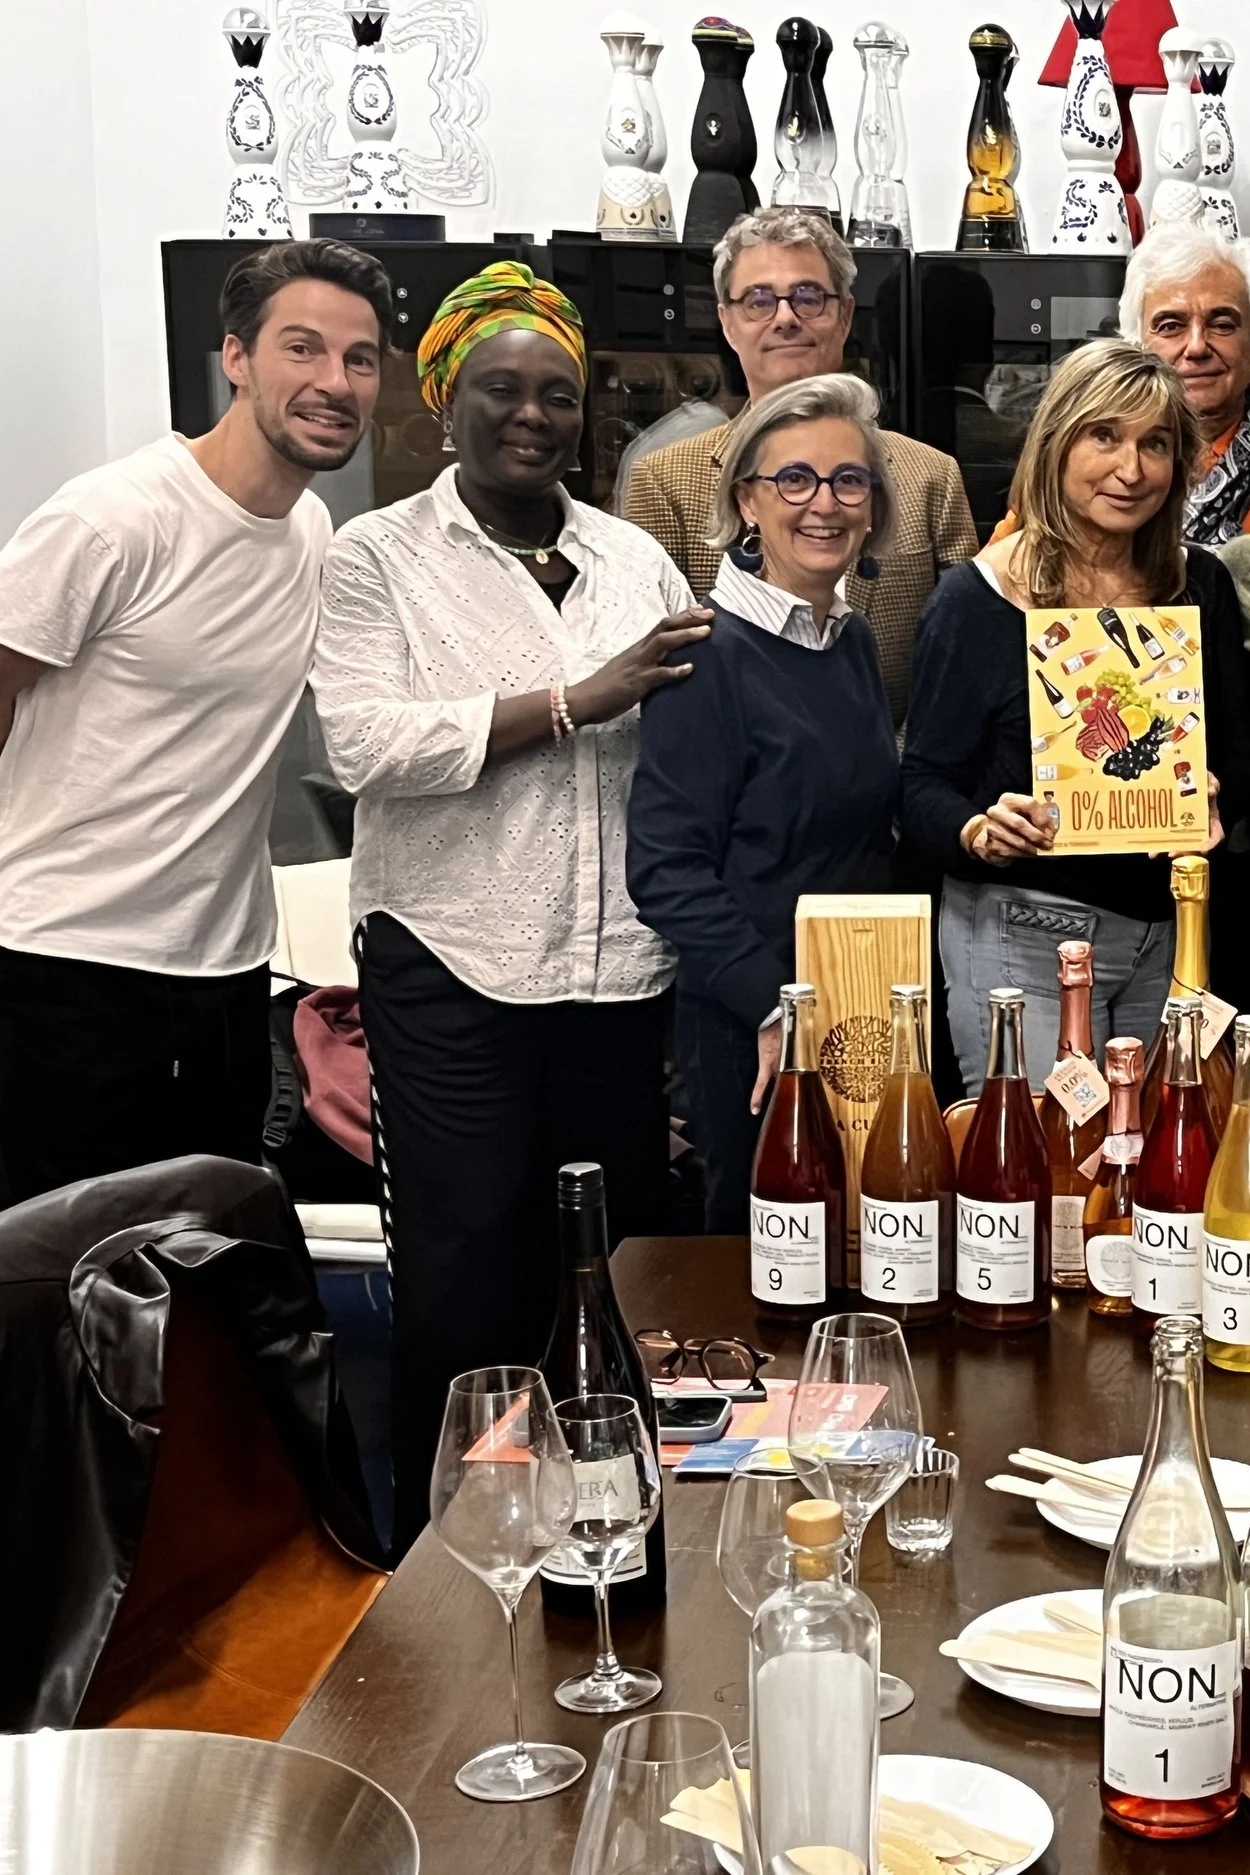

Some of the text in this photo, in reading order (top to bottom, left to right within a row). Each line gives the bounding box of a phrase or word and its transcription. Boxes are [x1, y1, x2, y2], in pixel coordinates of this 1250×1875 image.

[1071, 788, 1178, 831] 0% ALCOHOL
[752, 1207, 809, 1239] NON
[864, 1206, 923, 1238] NON
[960, 1206, 1019, 1239] NON
[1134, 1216, 1188, 1250] NON
[768, 1268, 783, 1291] 9
[881, 1267, 896, 1290] 2
[977, 1267, 992, 1291] 5
[1148, 1278, 1157, 1301] 1
[1223, 1307, 1238, 1331] 3
[1118, 1658, 1216, 1704] NON
[1154, 1748, 1169, 1783] 1
